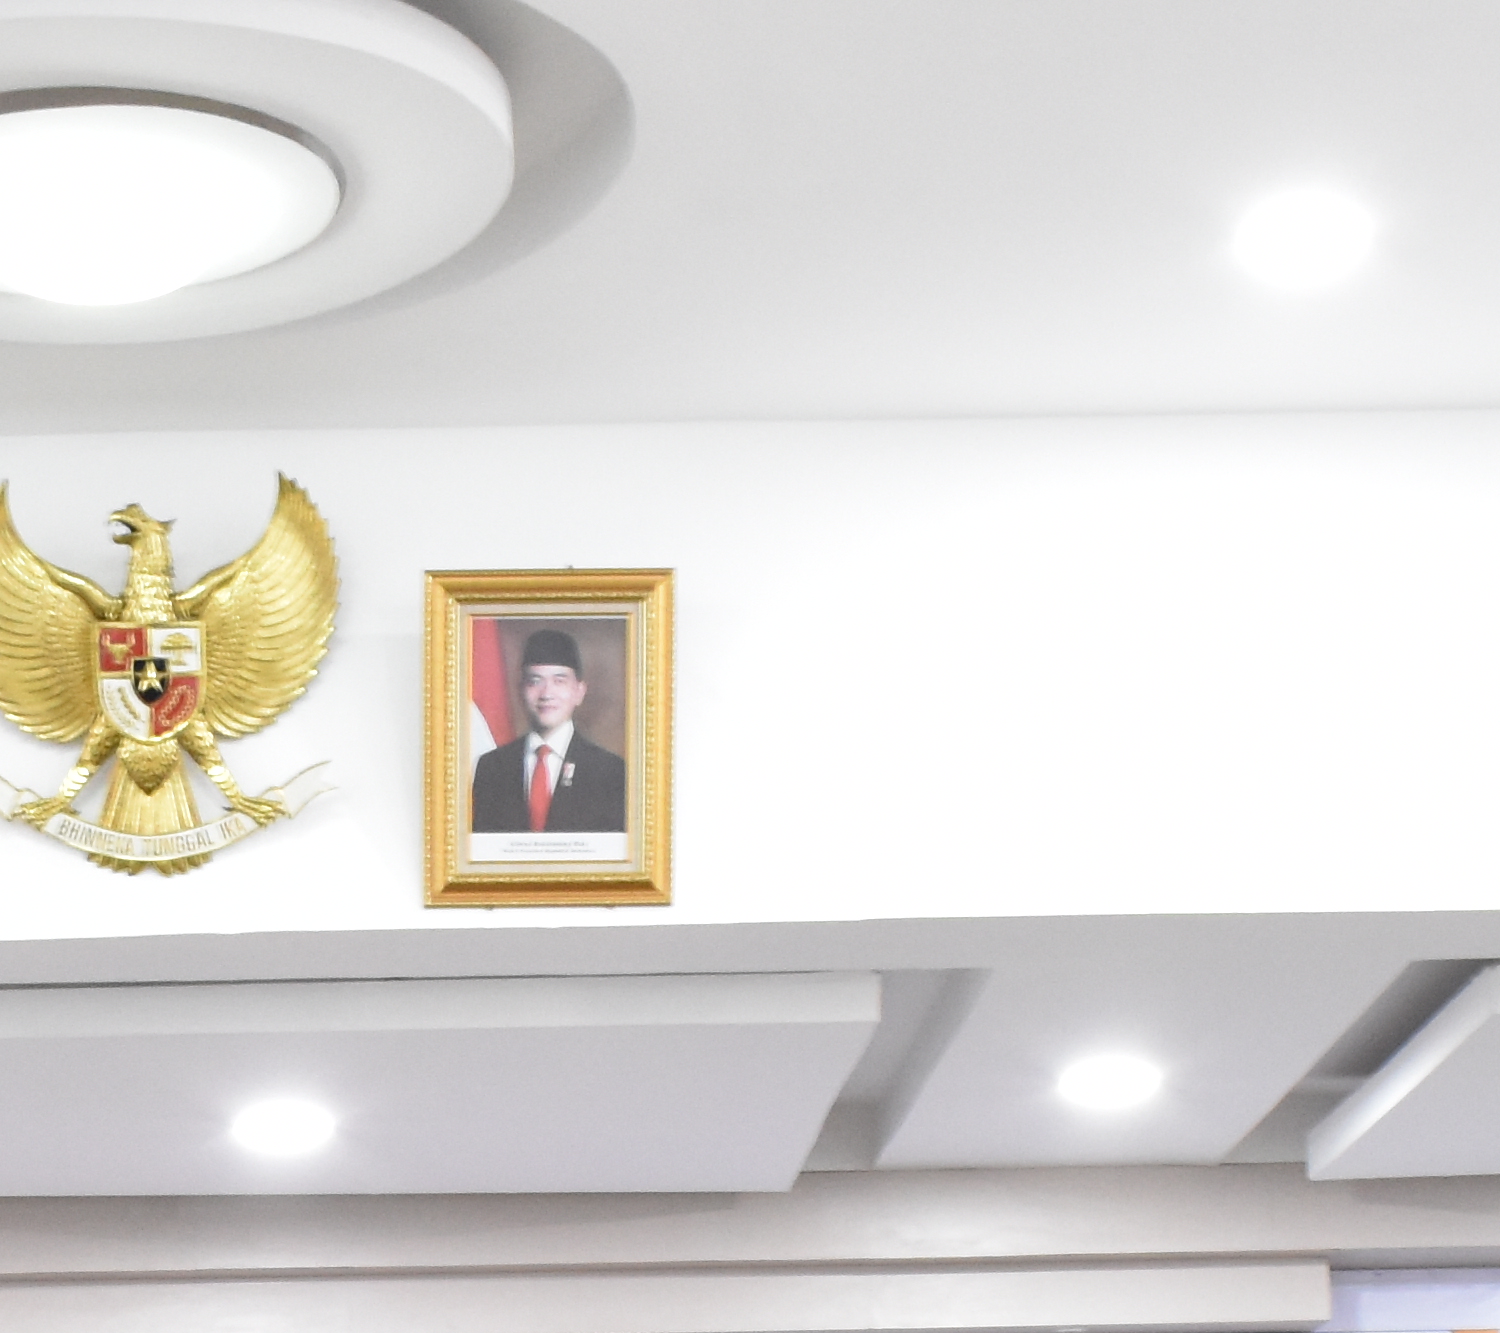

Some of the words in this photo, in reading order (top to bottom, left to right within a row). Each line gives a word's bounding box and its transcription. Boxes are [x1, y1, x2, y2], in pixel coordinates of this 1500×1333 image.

[58, 816, 134, 856] BHINNEKA
[143, 832, 214, 856] TUNGGAL
[220, 816, 247, 840] IKA
